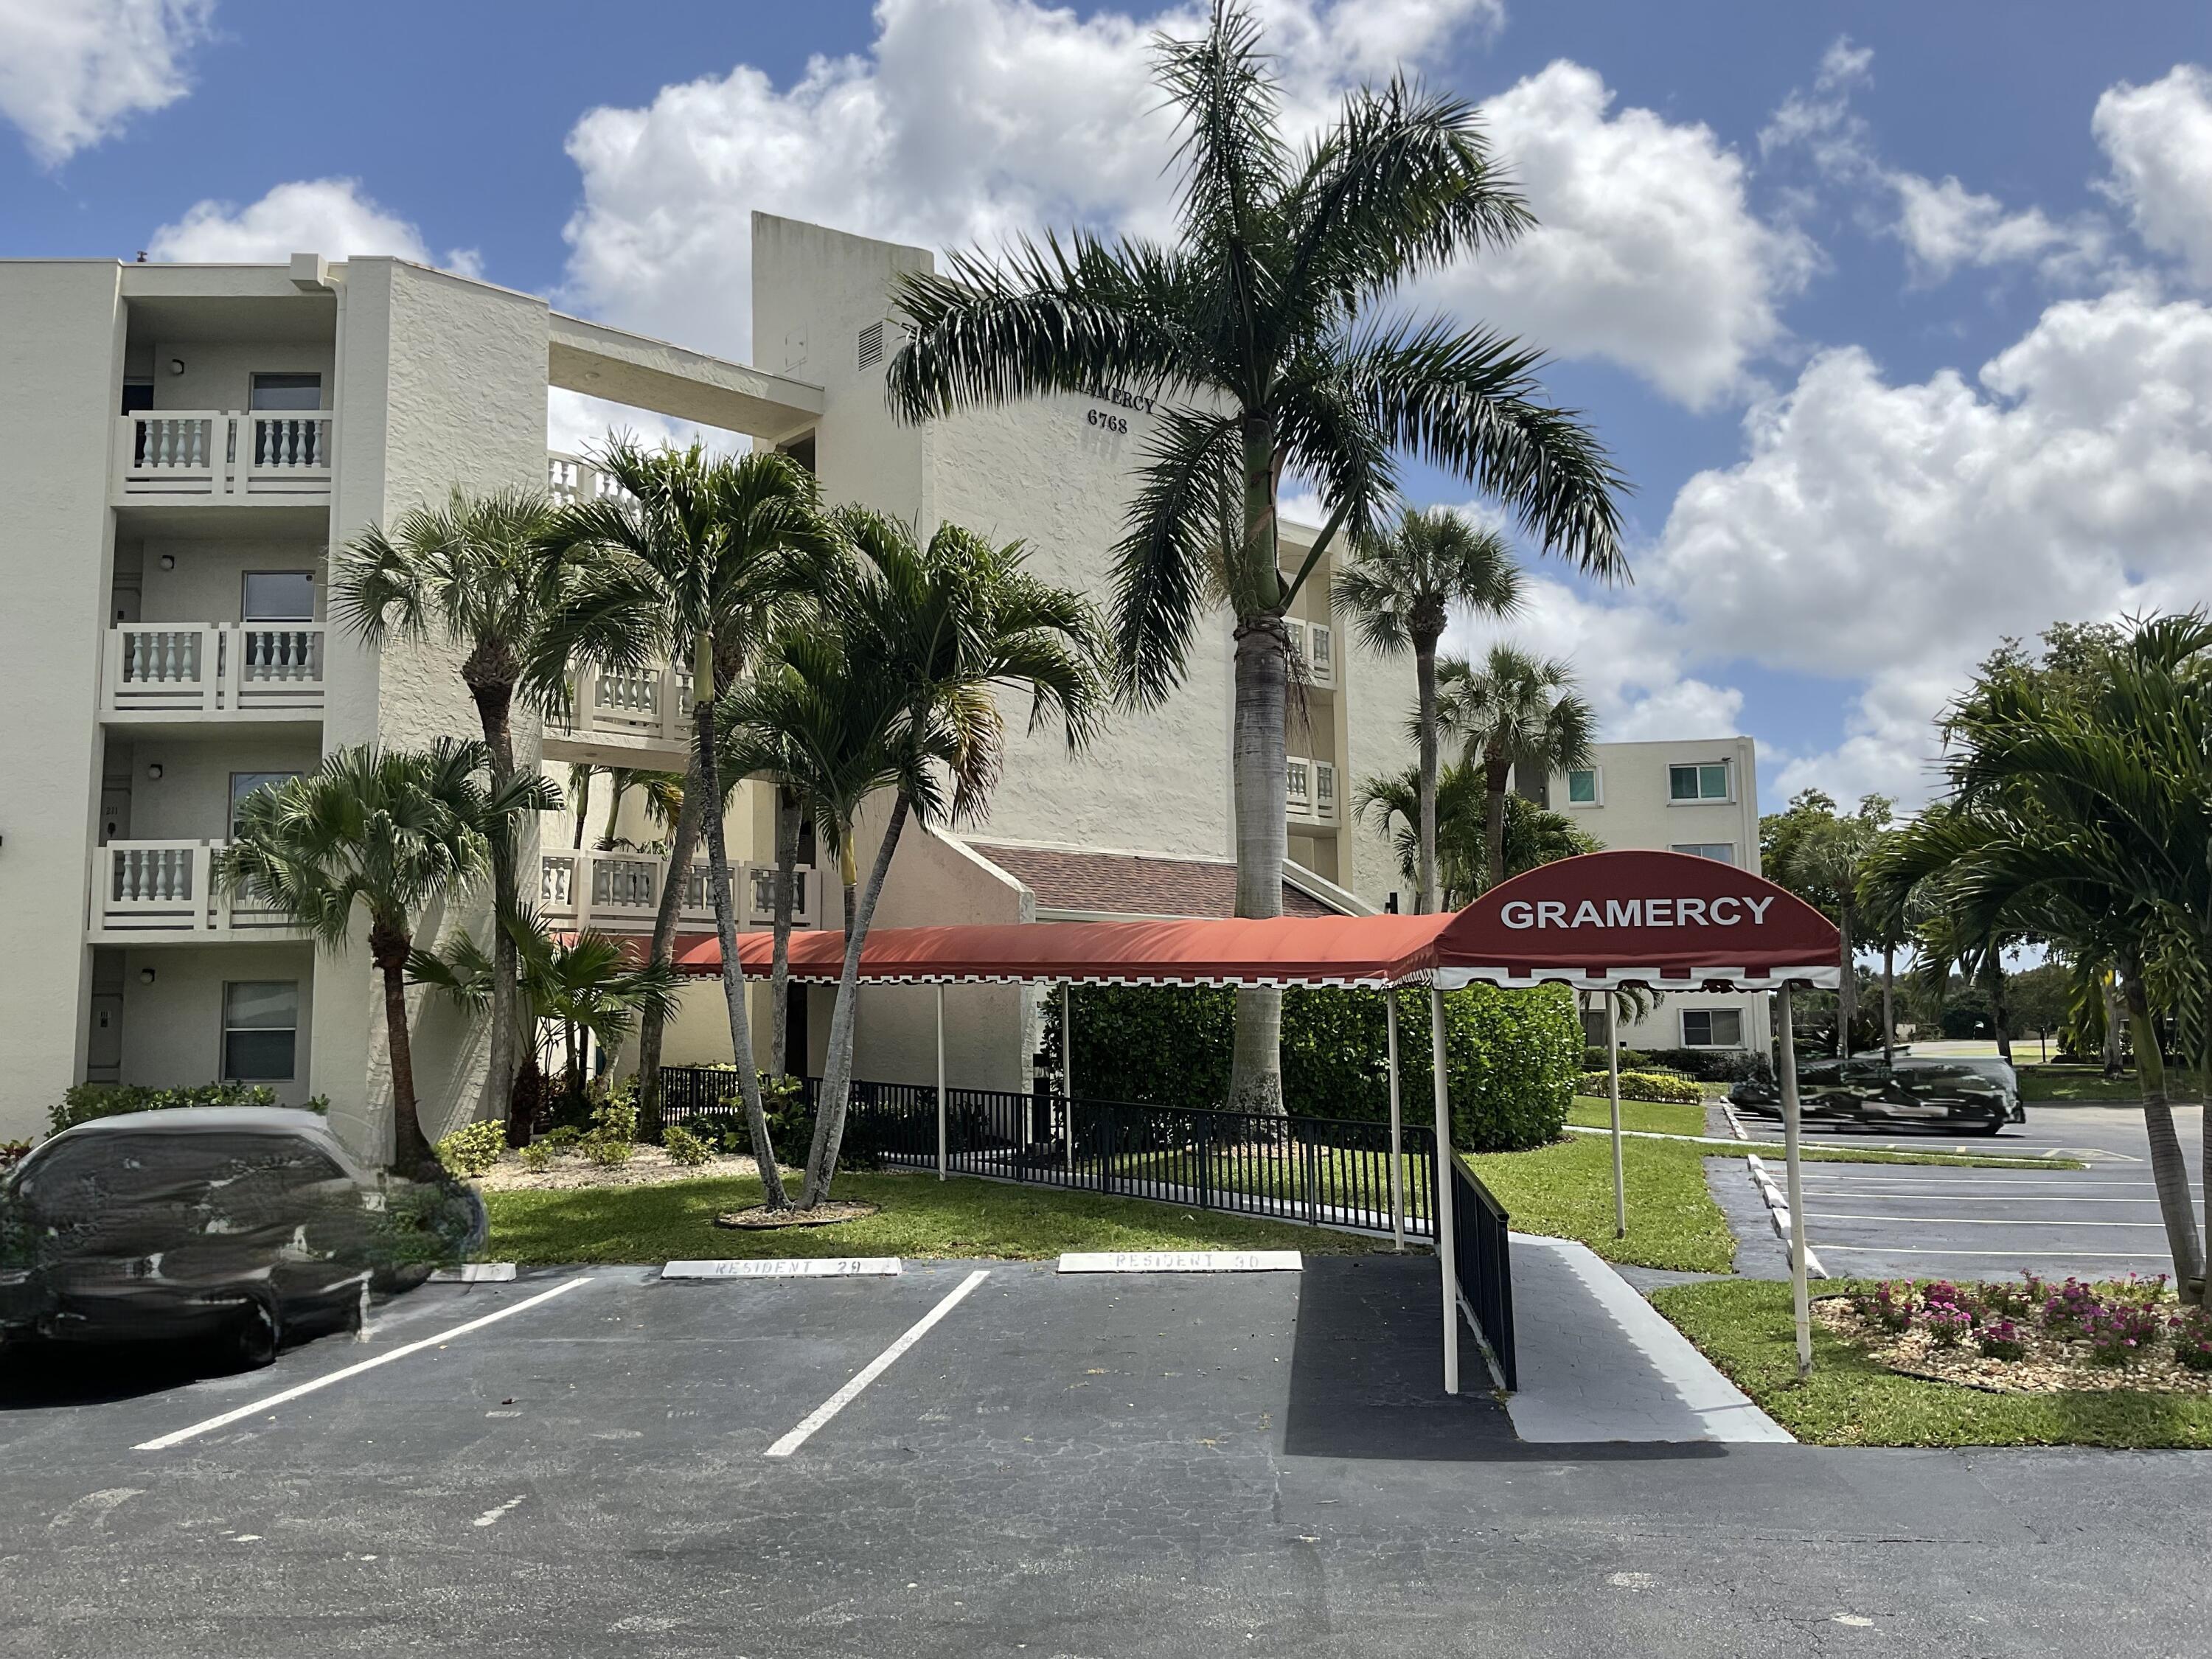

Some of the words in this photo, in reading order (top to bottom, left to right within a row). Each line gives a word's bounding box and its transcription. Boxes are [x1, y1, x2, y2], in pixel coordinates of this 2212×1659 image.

[1088, 409, 1127, 434] 6768
[105, 806, 118, 815] 211
[1500, 897, 1775, 929] GRAMERCY
[1116, 1253, 1213, 1267] RESIDENT
[715, 1261, 813, 1275] RESIDENT
